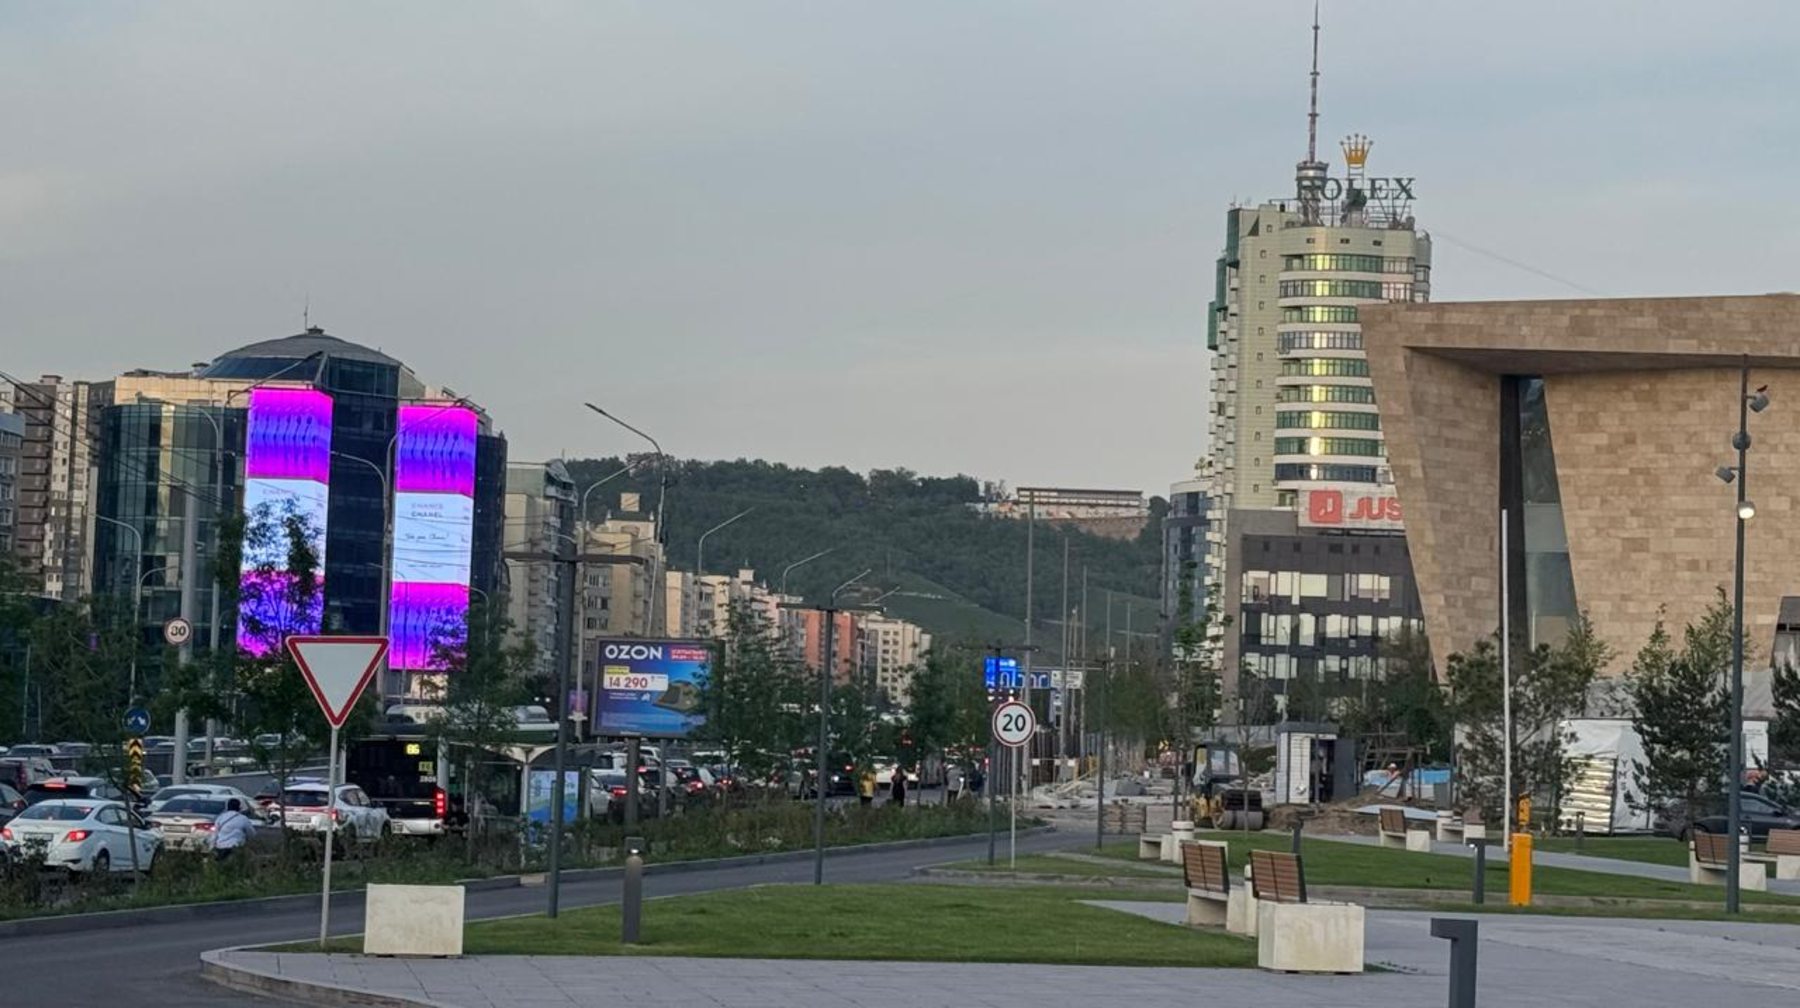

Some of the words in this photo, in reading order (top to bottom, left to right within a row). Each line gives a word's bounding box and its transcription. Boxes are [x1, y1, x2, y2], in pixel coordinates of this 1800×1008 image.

[1296, 177, 1417, 200] ROLEX
[605, 645, 663, 660] OZON
[609, 677, 621, 688] 14
[624, 677, 648, 688] 290
[1002, 713, 1026, 732] 20
